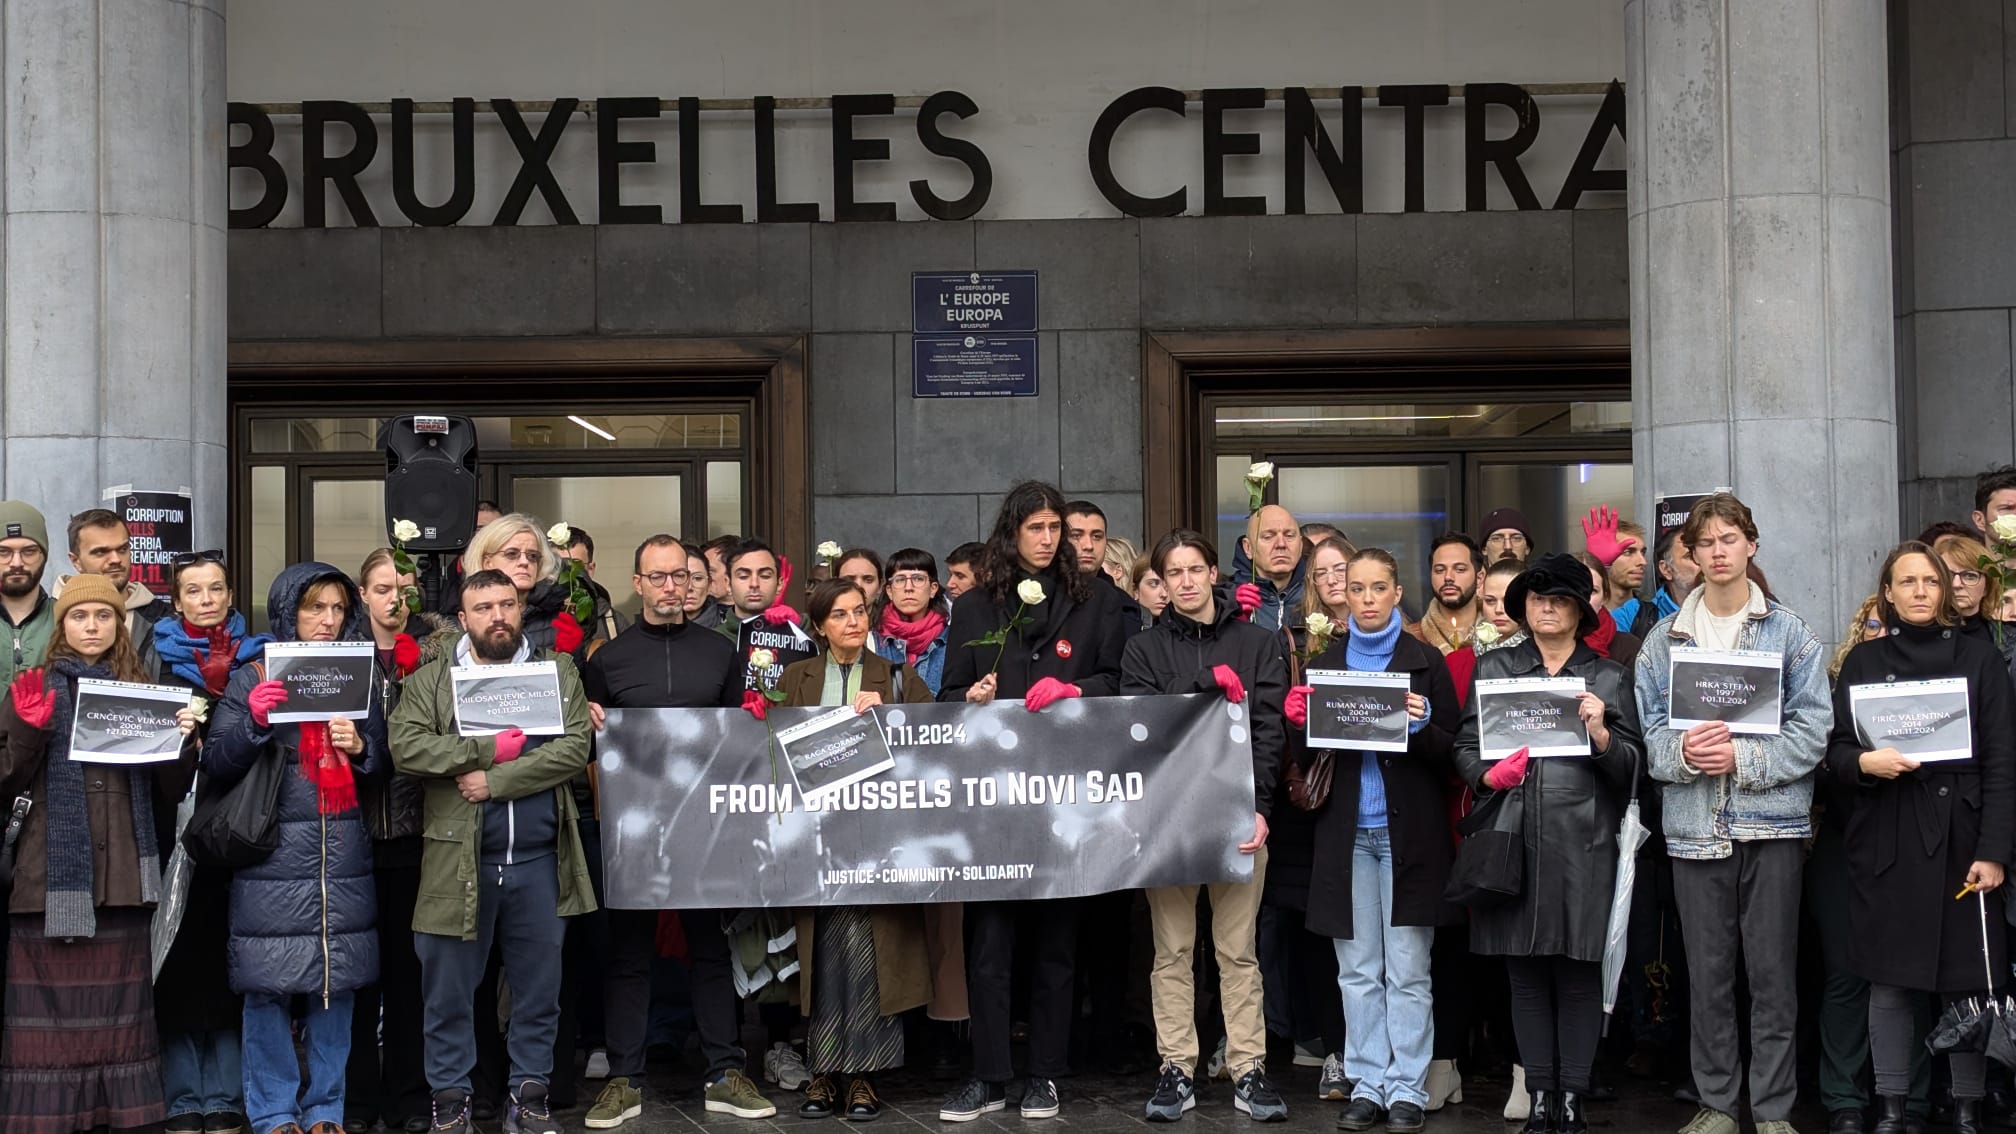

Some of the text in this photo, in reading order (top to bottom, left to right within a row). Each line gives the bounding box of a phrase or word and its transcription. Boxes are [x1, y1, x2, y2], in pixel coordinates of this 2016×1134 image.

[228, 91, 992, 228] BRUXELLES
[954, 292, 1010, 305] EUROPE
[947, 309, 1003, 321] EUROPA
[126, 508, 184, 523] CORRUPTION
[128, 536, 162, 550] SERBIA
[750, 630, 810, 652] CORRUPTION
[334, 674, 354, 682] ANJA
[1695, 680, 1756, 692] HRKA STEFAN
[1326, 701, 1356, 710] RUMAN
[1898, 712, 1951, 721] VALENTINA
[120, 722, 142, 730] 2006
[709, 784, 793, 813] FROM
[804, 778, 952, 812] BRUSSELS
[962, 777, 997, 807] TO
